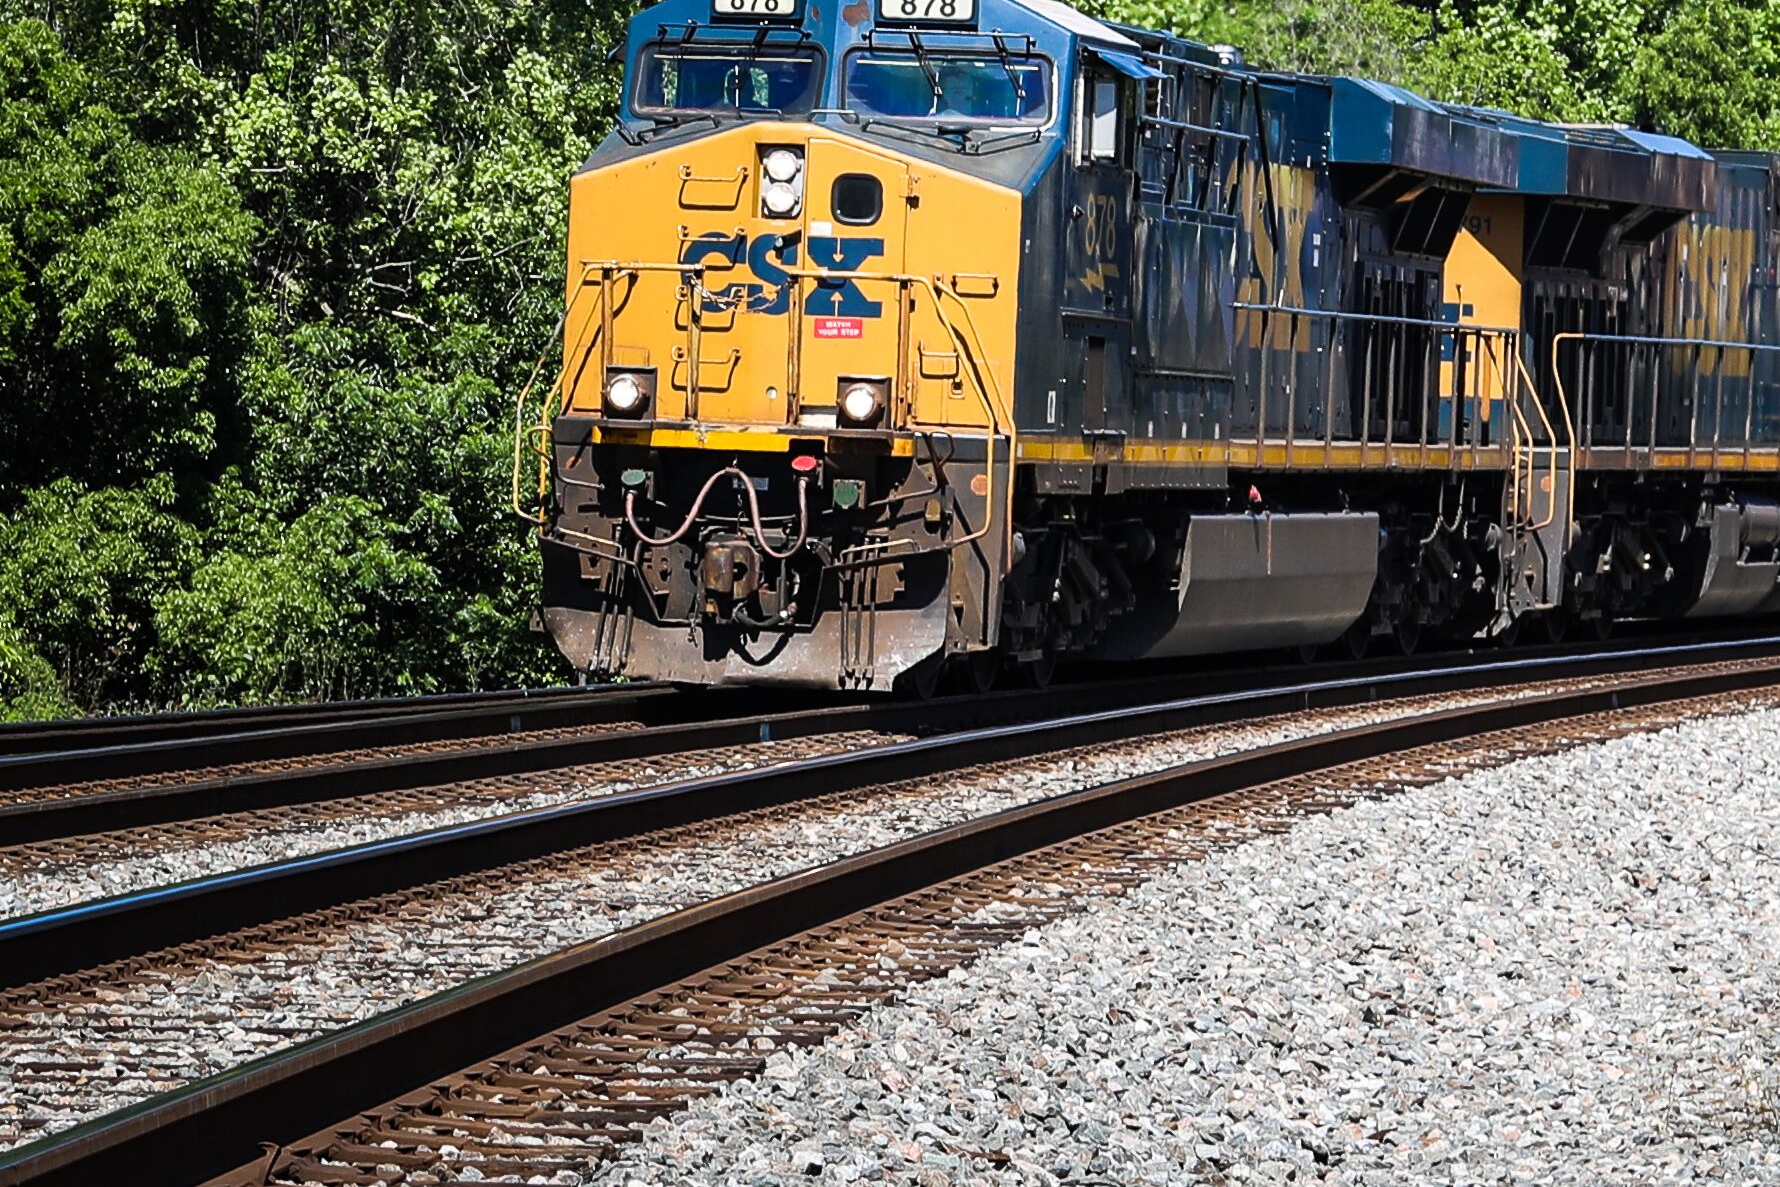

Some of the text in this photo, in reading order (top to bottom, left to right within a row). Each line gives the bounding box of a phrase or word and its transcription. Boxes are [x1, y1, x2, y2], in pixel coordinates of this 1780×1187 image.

[1085, 193, 1116, 260] 878
[681, 231, 885, 318] CSX
[817, 328, 860, 336] YOUR STEP
